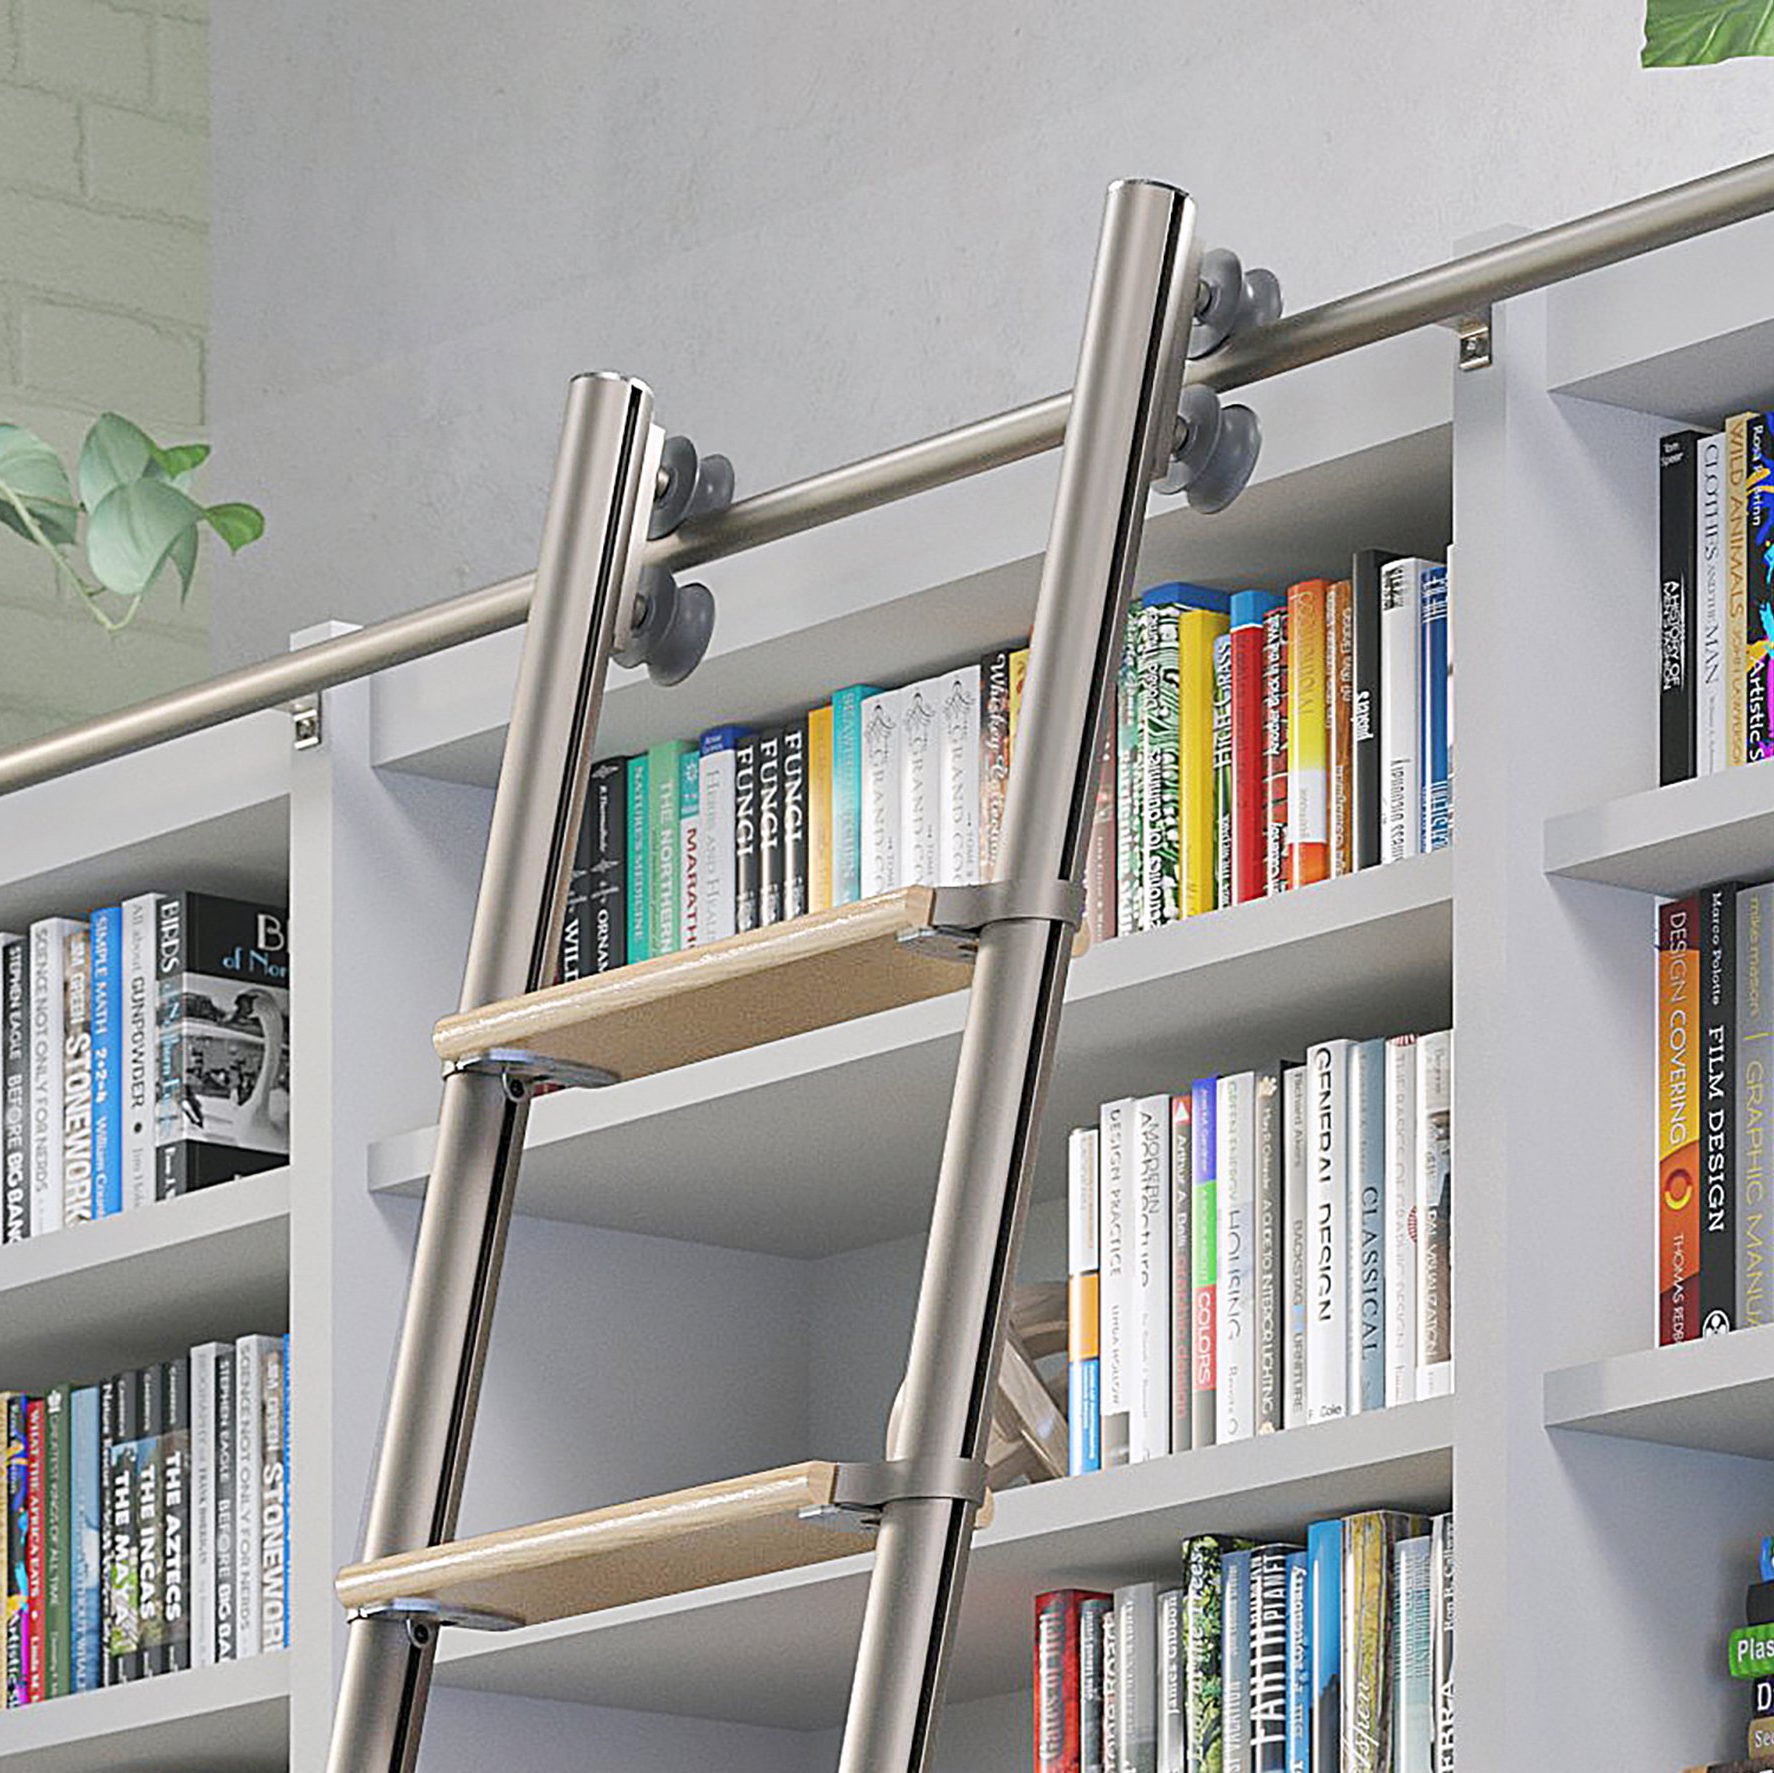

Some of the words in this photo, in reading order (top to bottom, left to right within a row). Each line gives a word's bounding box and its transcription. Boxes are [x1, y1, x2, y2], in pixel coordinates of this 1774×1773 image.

[1730, 421, 1744, 487] WILD
[1730, 495, 1744, 618] ANIMALS
[736, 747, 753, 858] FUNGI
[759, 739, 777, 851] FUNGI
[784, 731, 802, 843] FUNGI
[160, 901, 179, 973] BIRDS
[1670, 912, 1686, 1000] DESIGN
[1670, 1010, 1686, 1145] COVERING
[1708, 1025, 1724, 1100] FILM
[1708, 1109, 1724, 1231] DESIGN
[1746, 1061, 1762, 1205] GRAPHIC
[1360, 1186, 1378, 1361] CLASSICAL
[1196, 1292, 1211, 1385] COLORS
